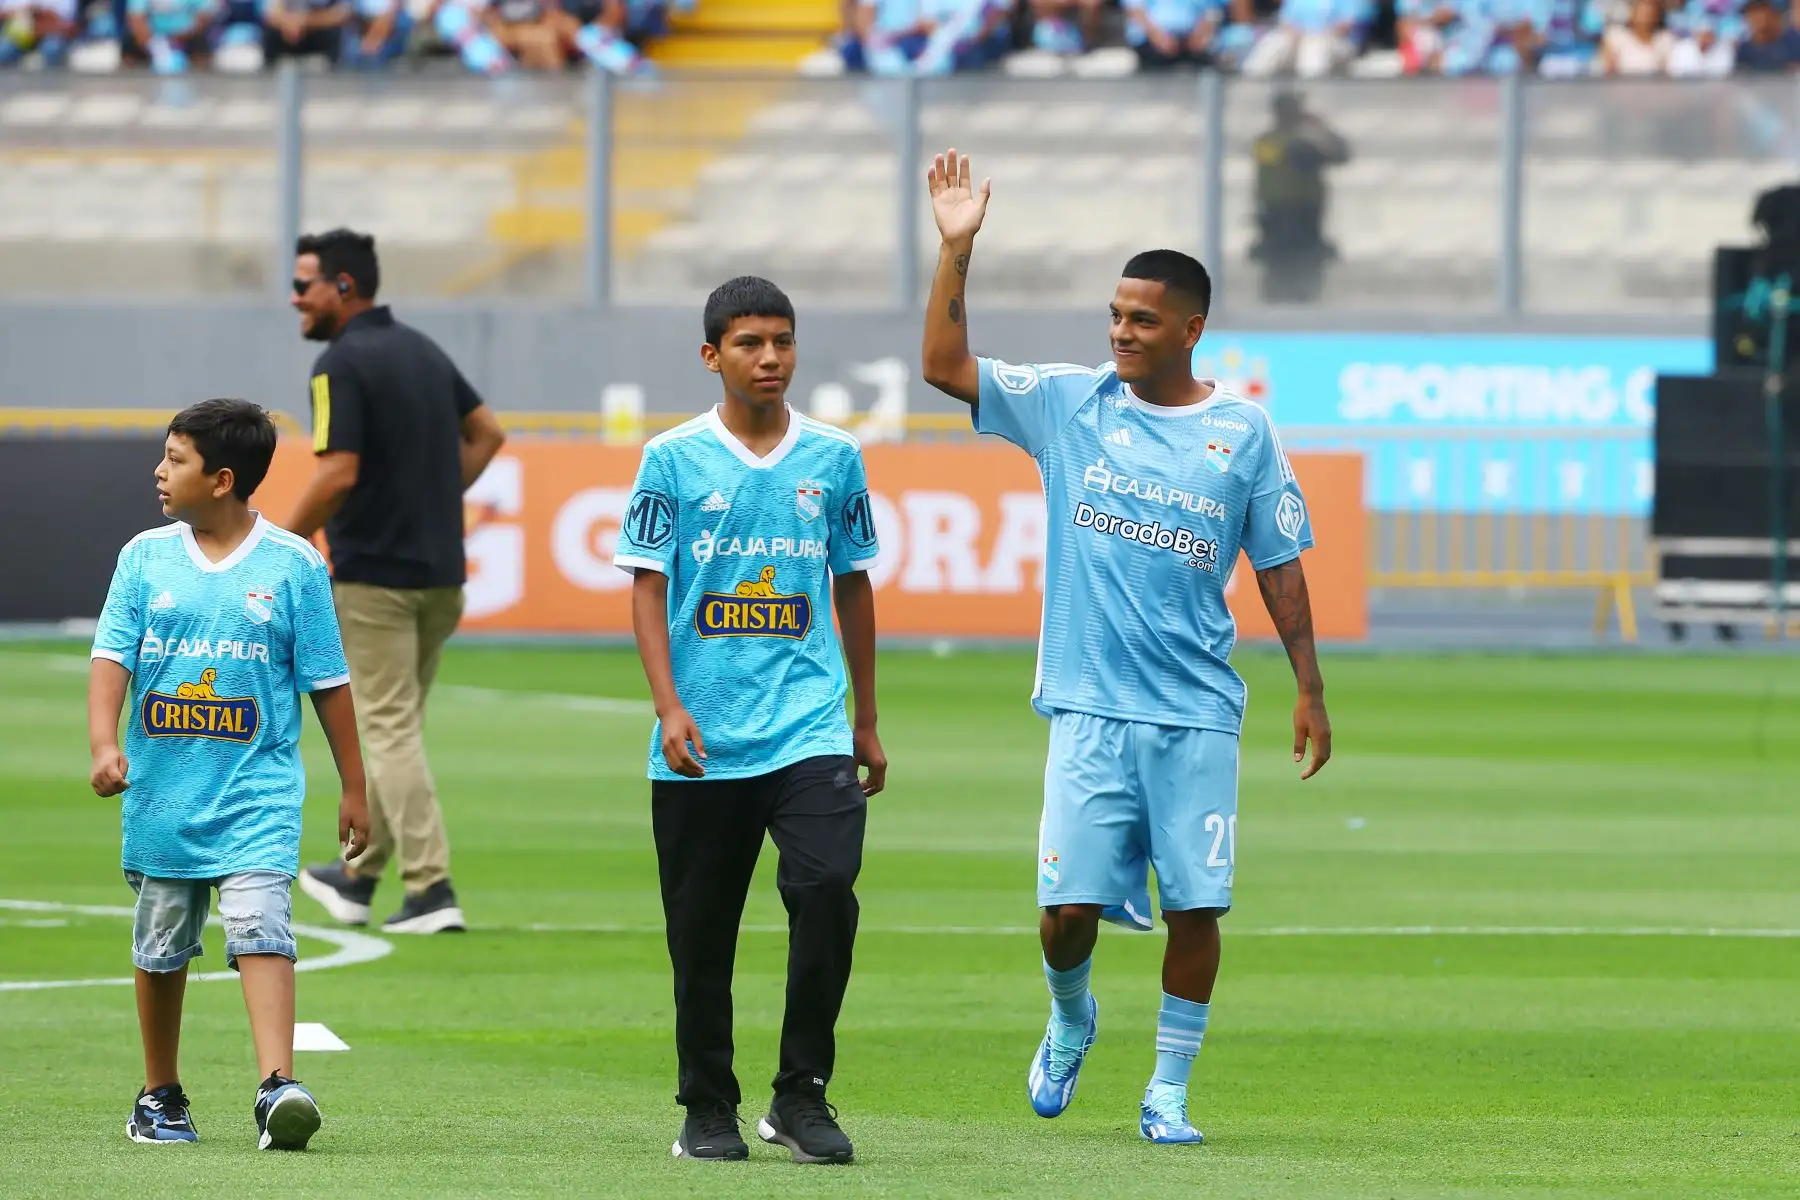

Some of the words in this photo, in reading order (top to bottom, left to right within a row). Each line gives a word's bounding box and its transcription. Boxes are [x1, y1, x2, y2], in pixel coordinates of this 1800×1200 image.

[1339, 361, 1617, 421] SPORTING
[701, 503, 731, 512] adidas
[1112, 476, 1165, 505] CAJA
[1166, 489, 1226, 521] PIURA
[630, 495, 671, 545] MG
[1074, 502, 1218, 562] DoradoBet
[716, 536, 769, 556] CAJA
[771, 538, 824, 559] PIURA
[1183, 556, 1215, 574] .com
[705, 600, 801, 631] CRISTAL
[165, 638, 215, 660] CAJA
[150, 700, 249, 733] CRISTAL
